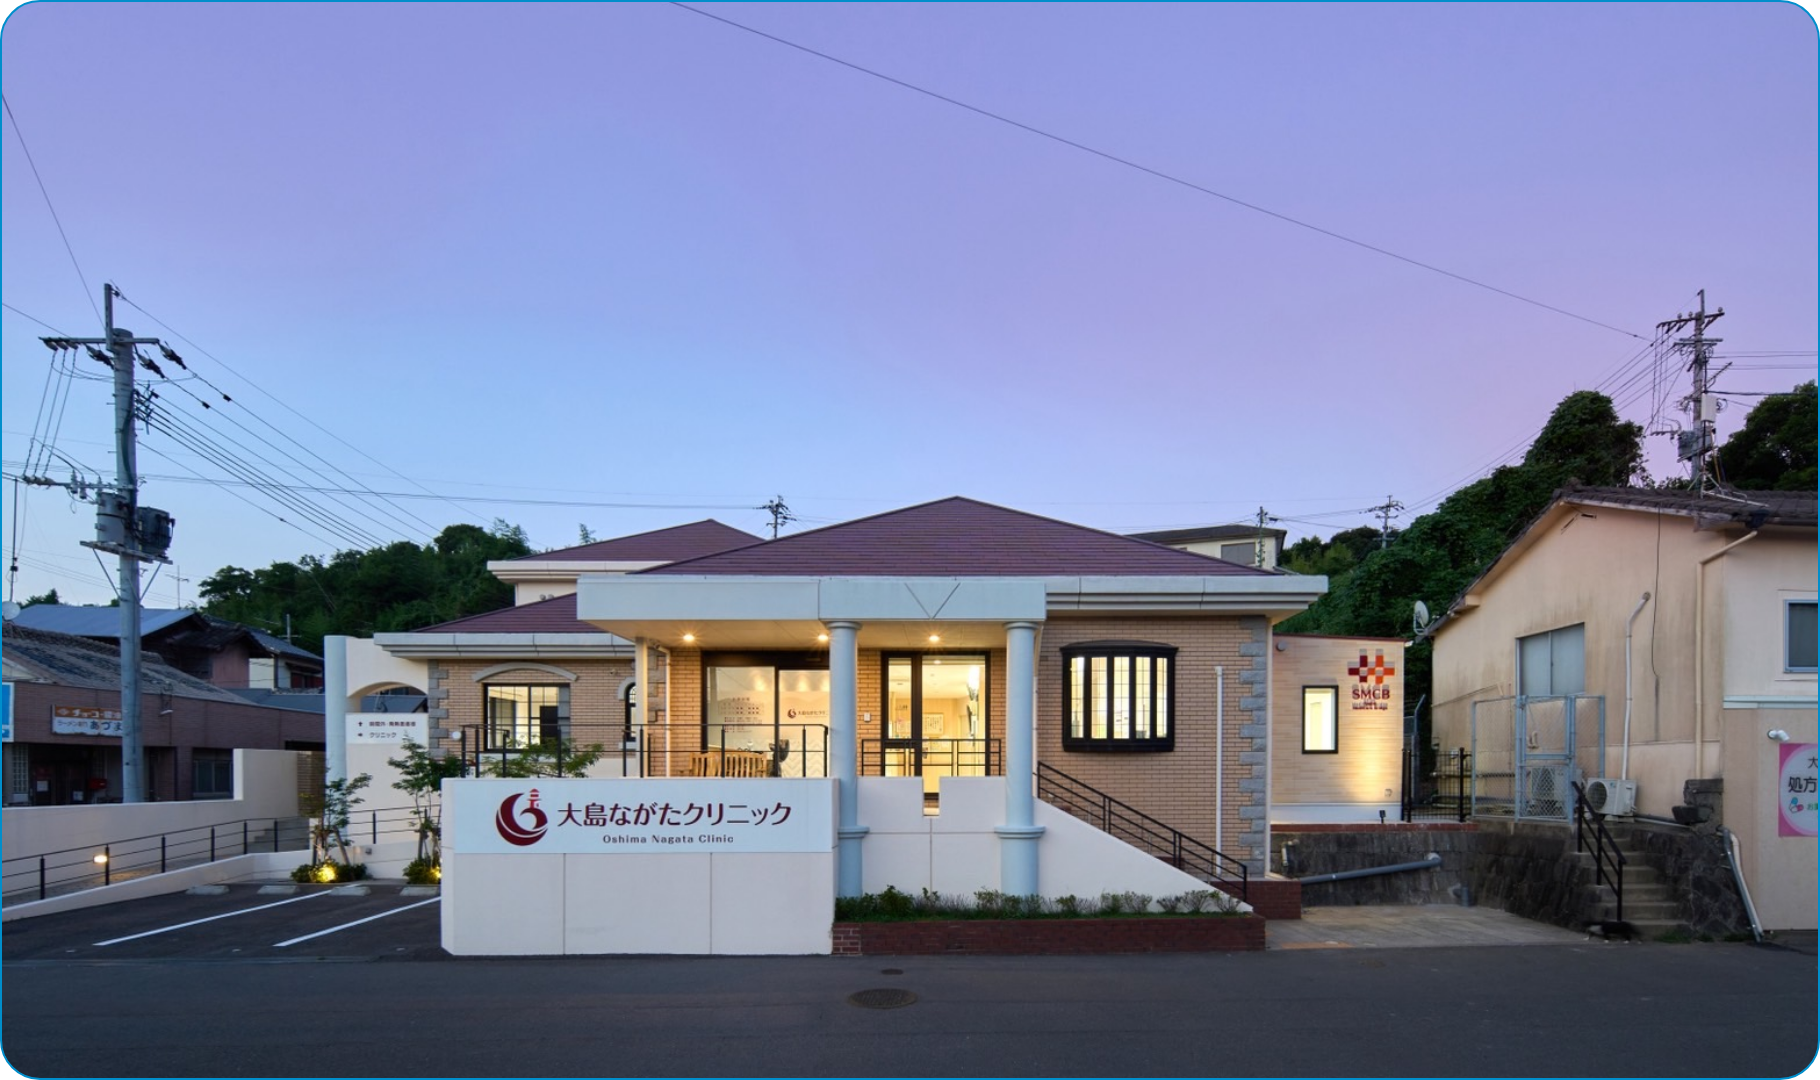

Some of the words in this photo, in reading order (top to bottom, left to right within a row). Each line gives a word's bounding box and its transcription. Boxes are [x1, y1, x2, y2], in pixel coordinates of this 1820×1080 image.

[1352, 688, 1391, 700] SMCB
[557, 802, 792, 827] 大島ながたクリニック
[603, 834, 647, 843] Oshima
[652, 834, 694, 844] Nagata
[698, 834, 734, 843] Clinic
